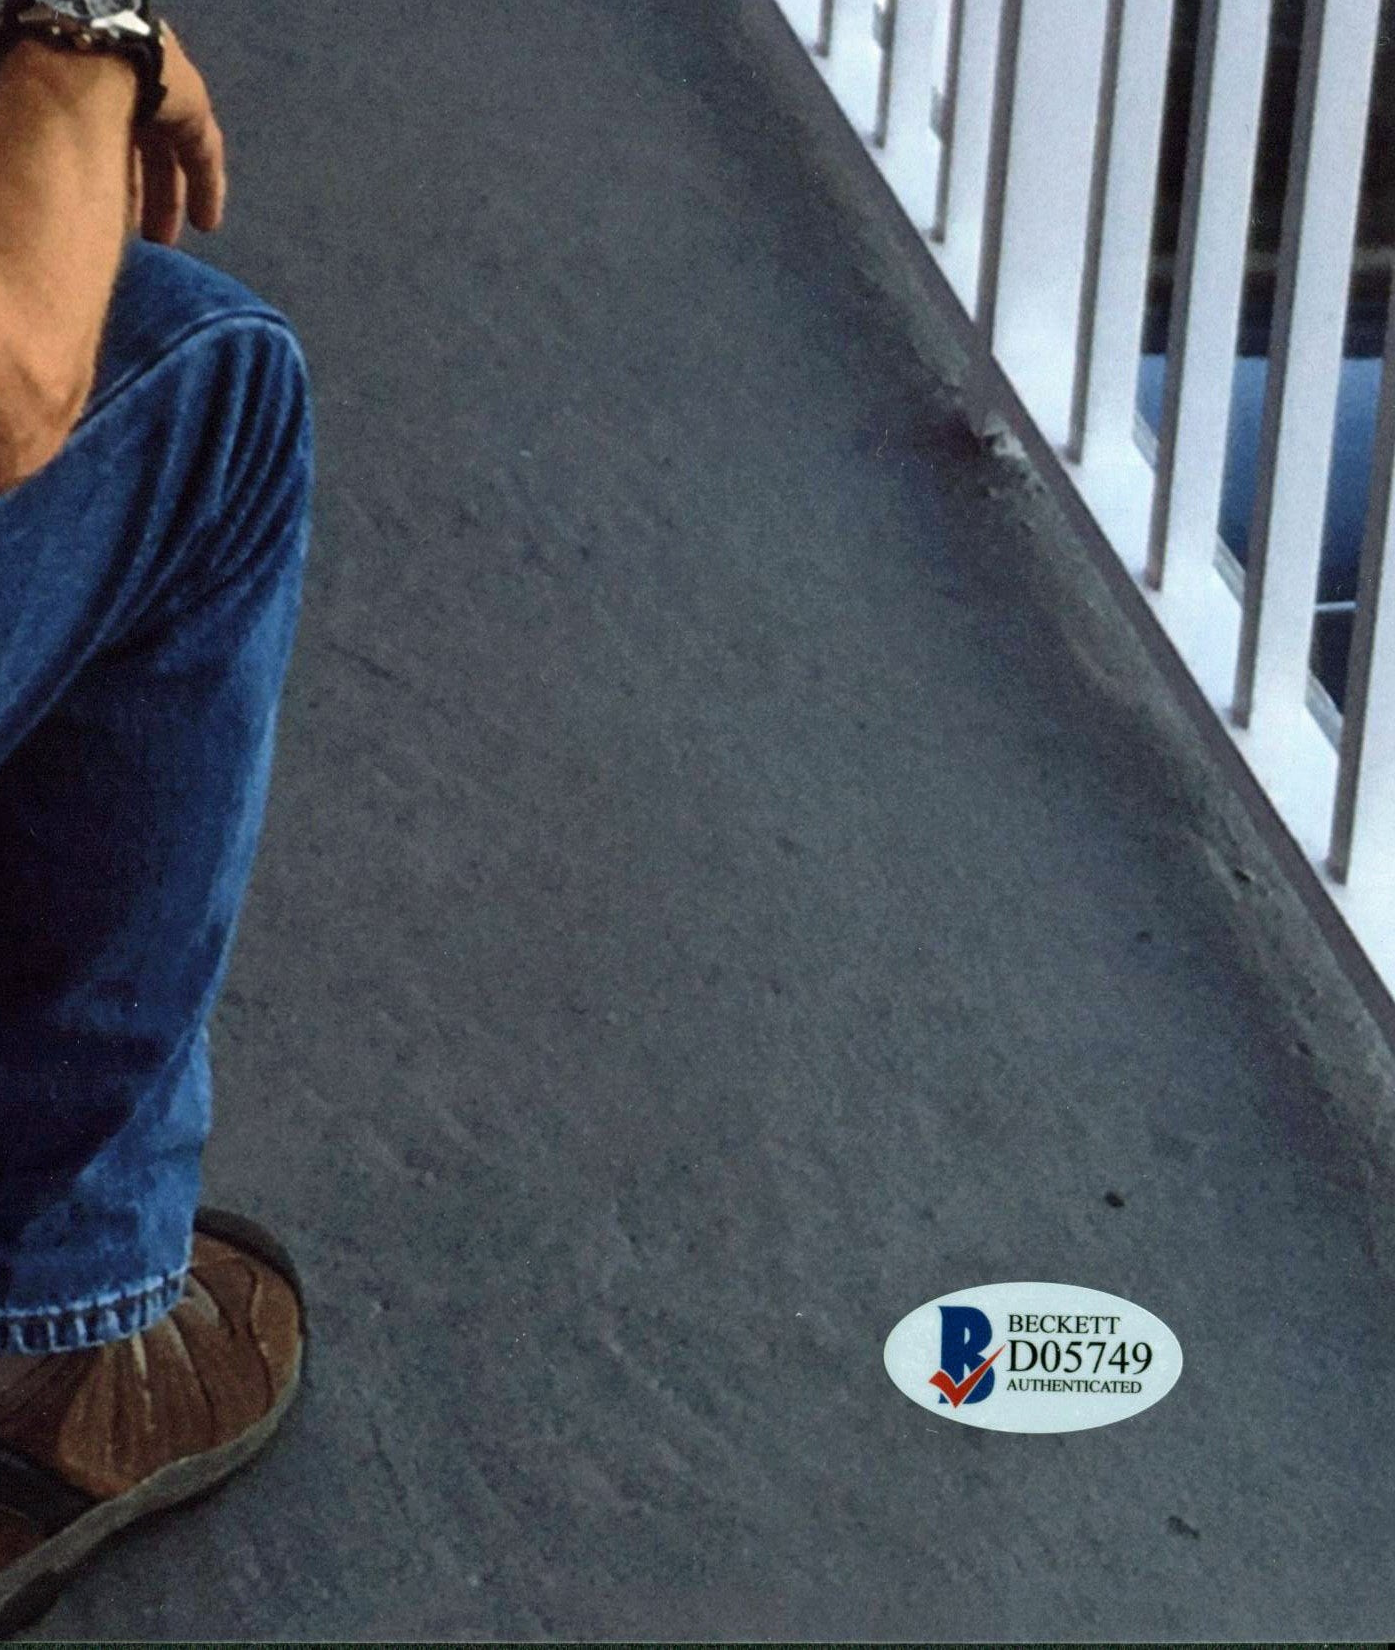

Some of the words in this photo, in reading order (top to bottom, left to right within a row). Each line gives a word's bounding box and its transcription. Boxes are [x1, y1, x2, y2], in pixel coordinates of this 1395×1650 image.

[1008, 1314, 1120, 1334] BECKETT
[1007, 1339, 1152, 1374] D05749
[1007, 1378, 1142, 1394] AUTHENTICATED
